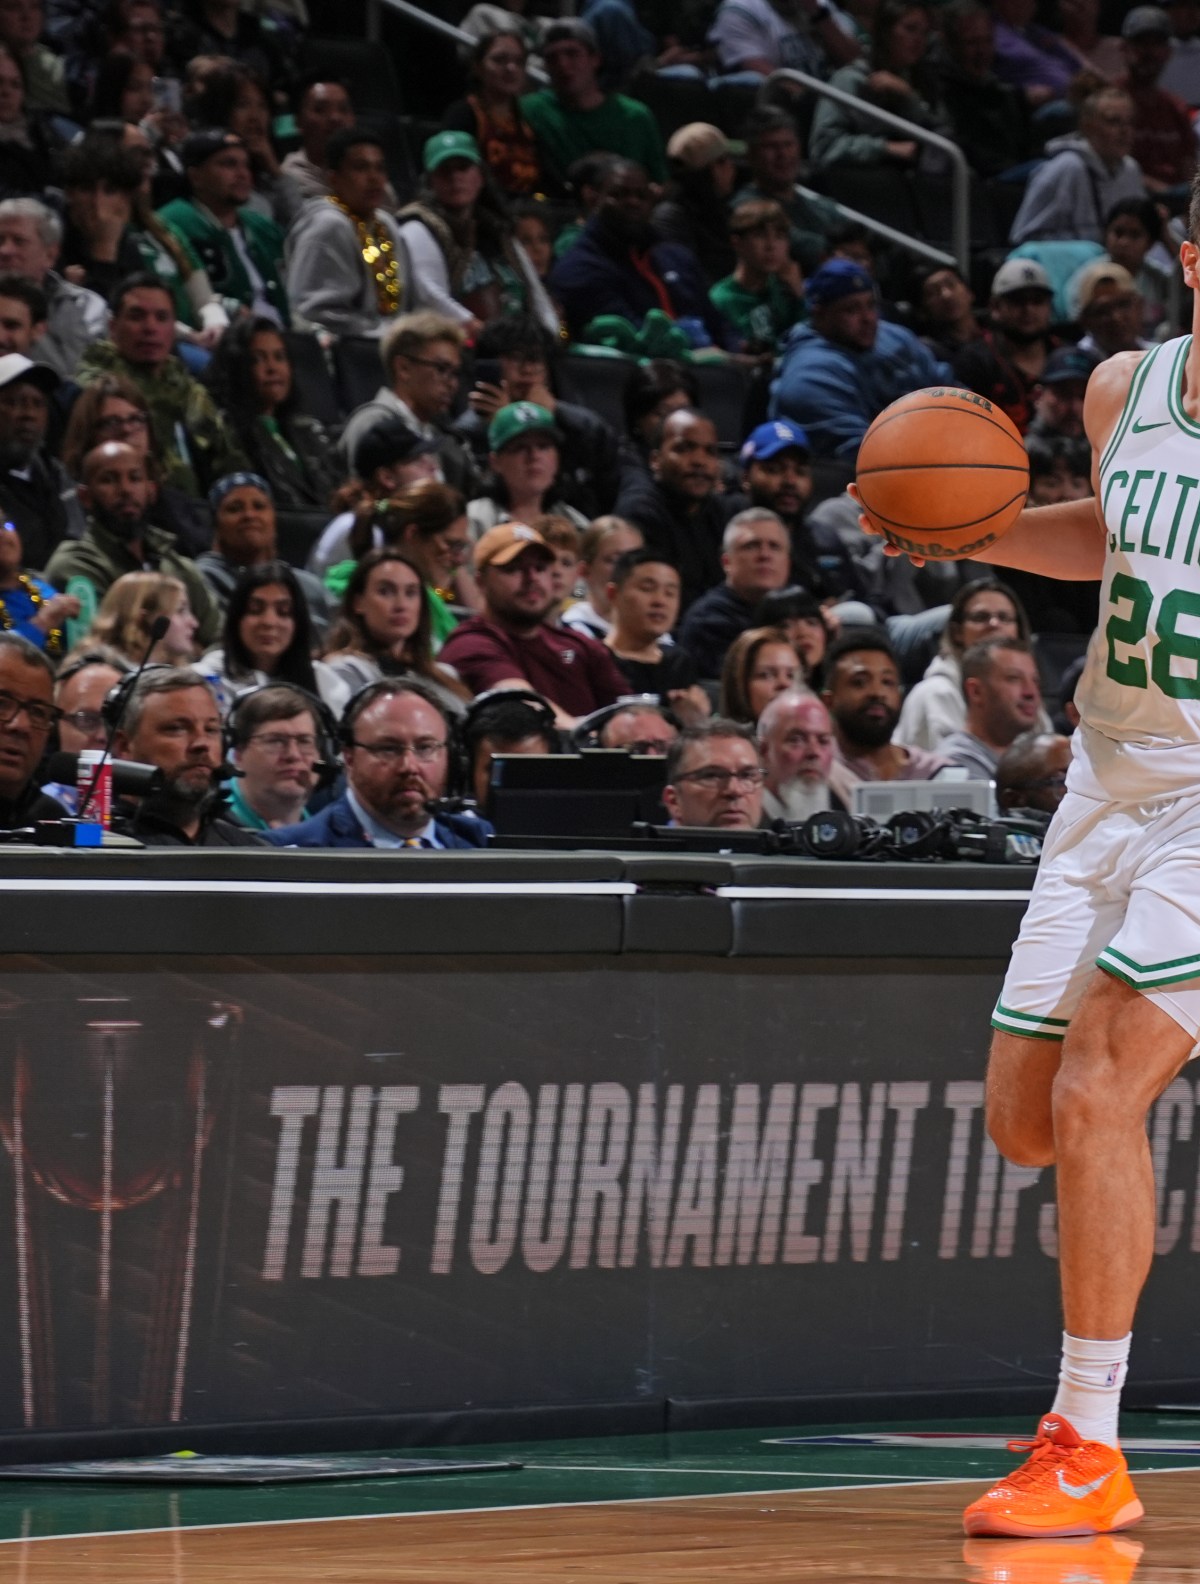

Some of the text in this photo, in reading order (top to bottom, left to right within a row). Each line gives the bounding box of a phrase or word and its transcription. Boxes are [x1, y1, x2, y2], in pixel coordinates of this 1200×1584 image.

[881, 526, 996, 557] Wilson
[261, 1085, 420, 1281] THE
[430, 1081, 931, 1275] TOURNAMENT
[938, 1080, 1060, 1259] TIP
